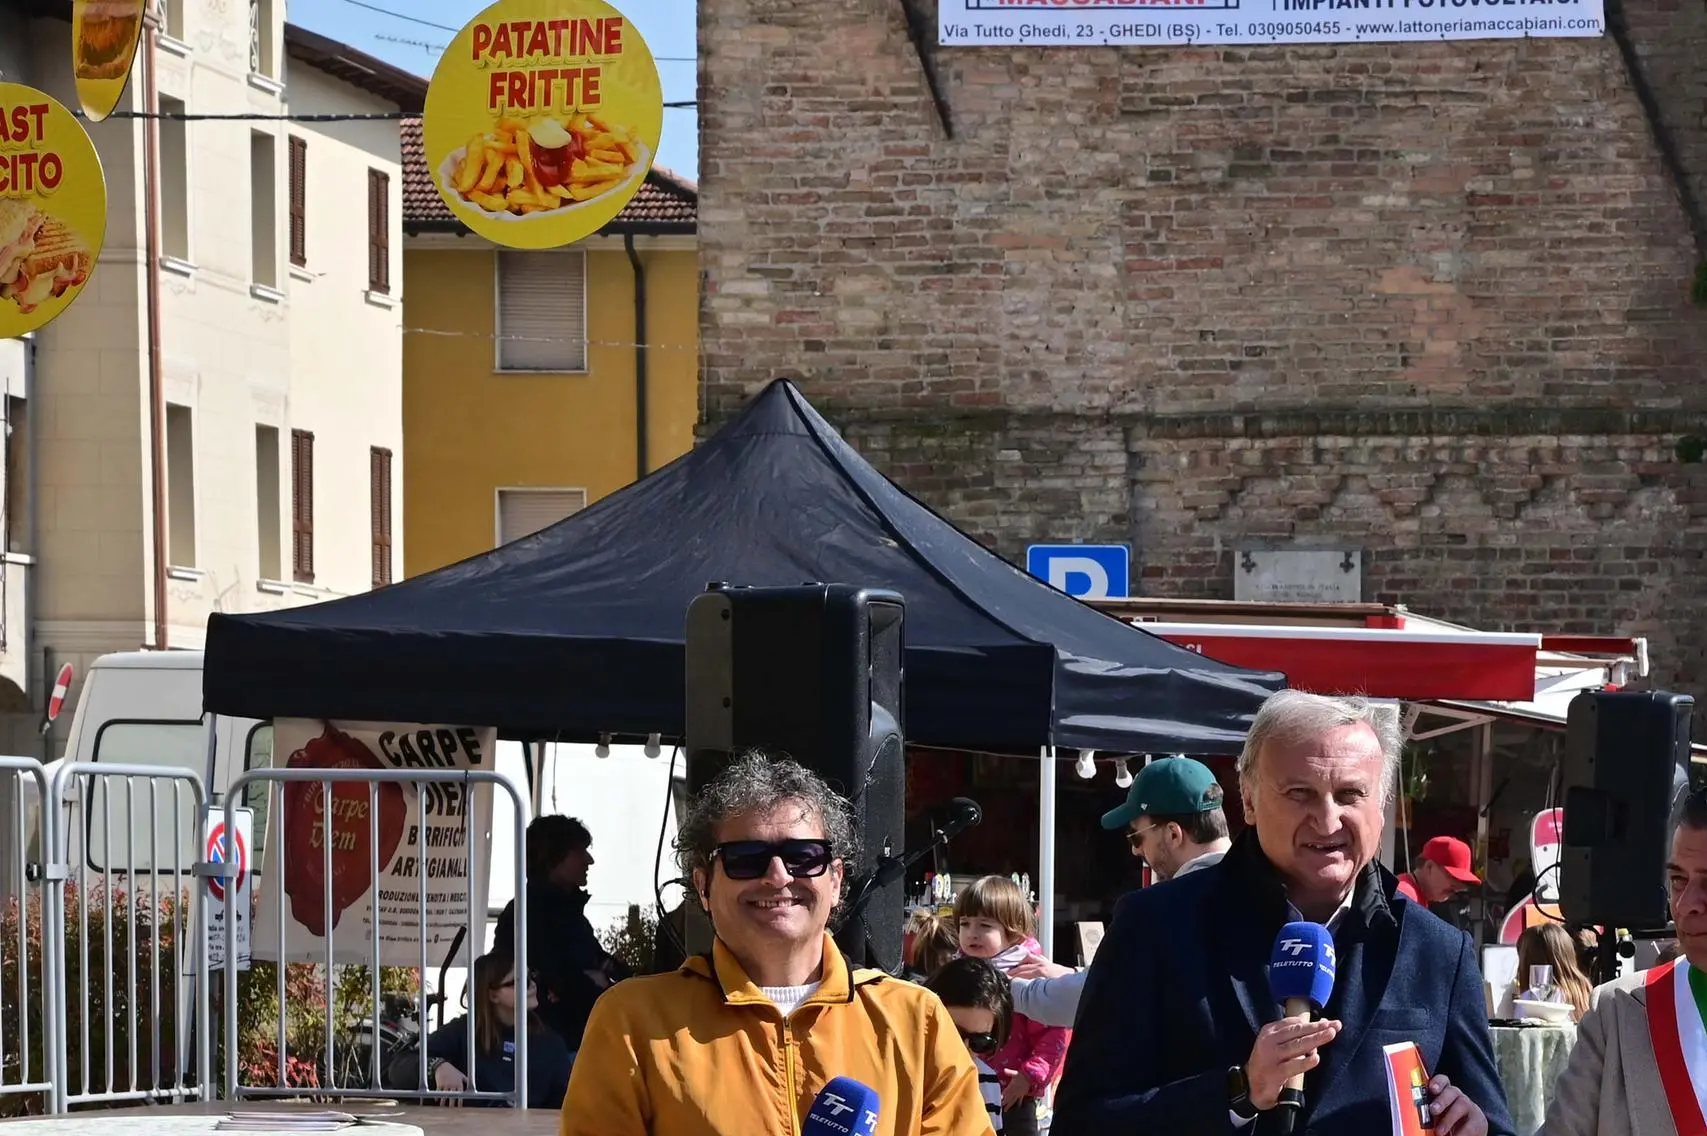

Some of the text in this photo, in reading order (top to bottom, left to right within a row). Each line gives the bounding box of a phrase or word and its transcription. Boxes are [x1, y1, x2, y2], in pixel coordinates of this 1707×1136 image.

[473, 17, 622, 60] PATATINE
[944, 24, 968, 37] Via
[974, 24, 1014, 37] Tutto
[1019, 24, 1070, 39] Ghedi,
[1076, 24, 1094, 37] 23
[1109, 24, 1162, 37] GHEDI
[1167, 23, 1201, 39] (BS)
[1216, 23, 1243, 36] Tel.
[1248, 22, 1341, 36] 0309050455
[1356, 17, 1600, 34] www.lattoneriamaccabiani.com
[490, 67, 600, 109] FRITTE
[1049, 557, 1108, 600] P
[378, 727, 482, 767] CARPE
[407, 825, 467, 847] BRRIFICIO
[1273, 960, 1313, 968] TELETUTTO
[809, 1113, 849, 1133] TELETUTTO
